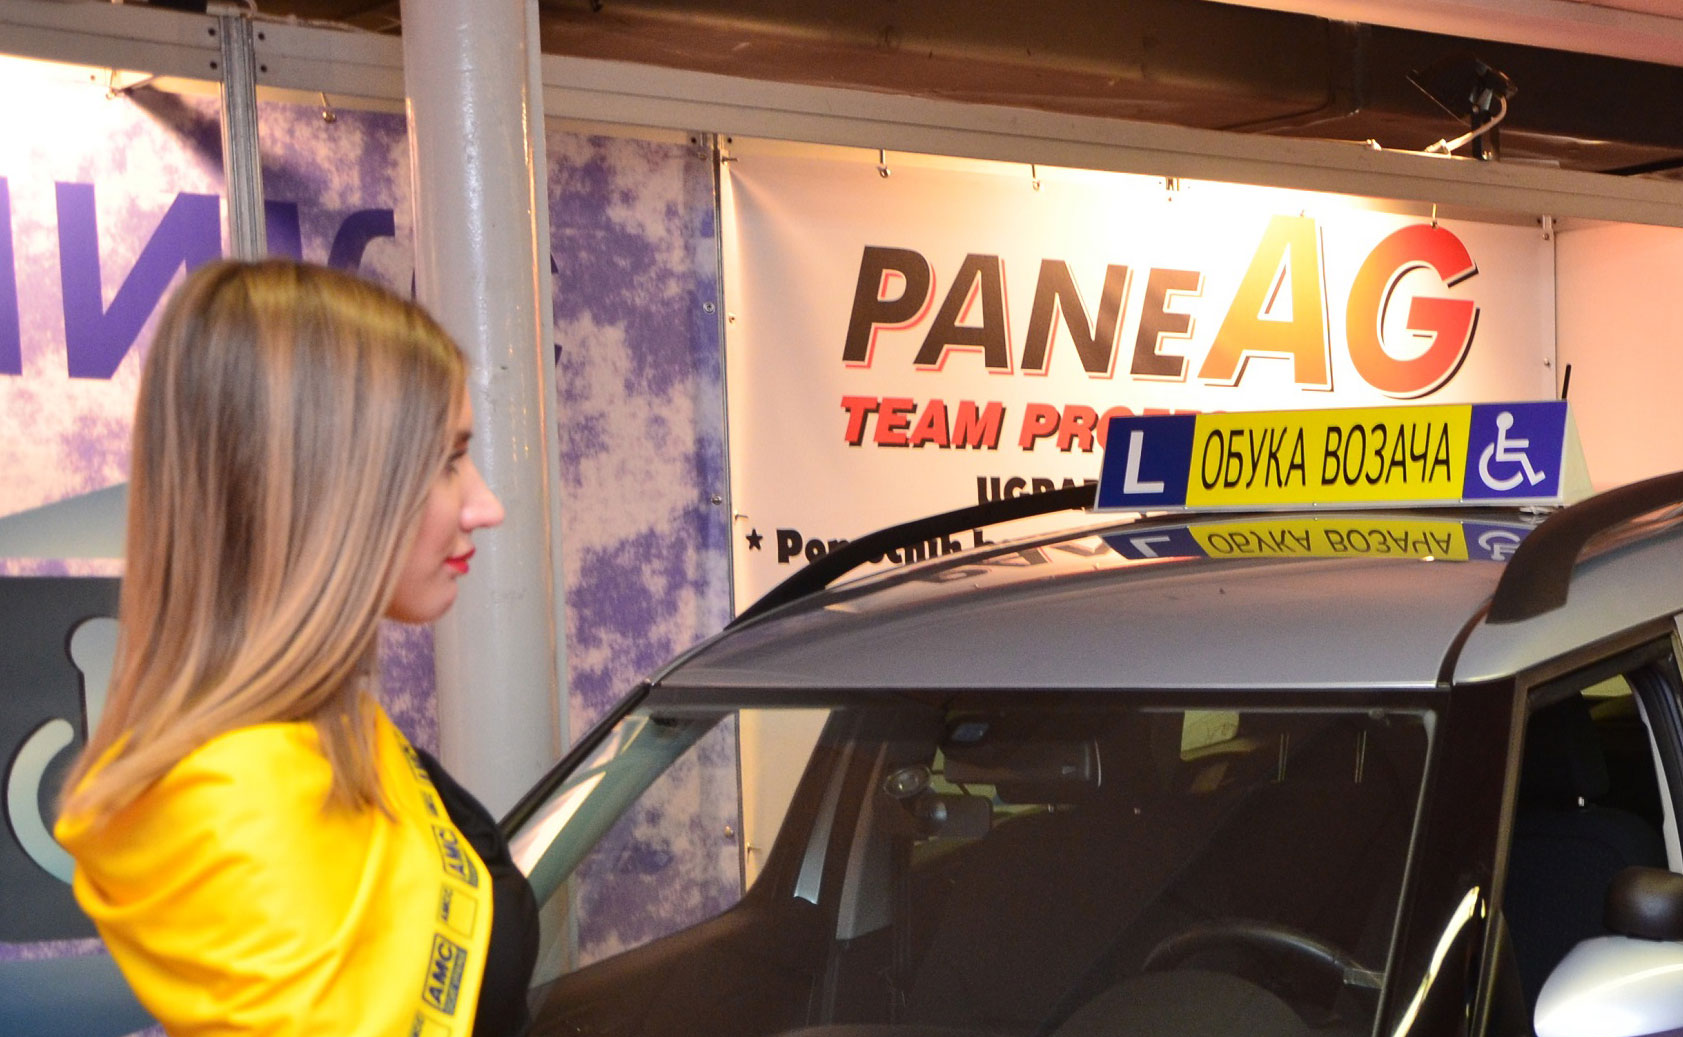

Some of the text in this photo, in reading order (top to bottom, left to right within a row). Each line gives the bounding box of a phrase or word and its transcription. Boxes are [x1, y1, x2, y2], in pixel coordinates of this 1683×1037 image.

[842, 214, 1481, 400] PANEAG
[840, 395, 1007, 450] TEAM
[1122, 430, 1166, 494] L
[1200, 426, 1306, 490] ОБУКА
[1320, 422, 1452, 486] ВОЗАЧА
